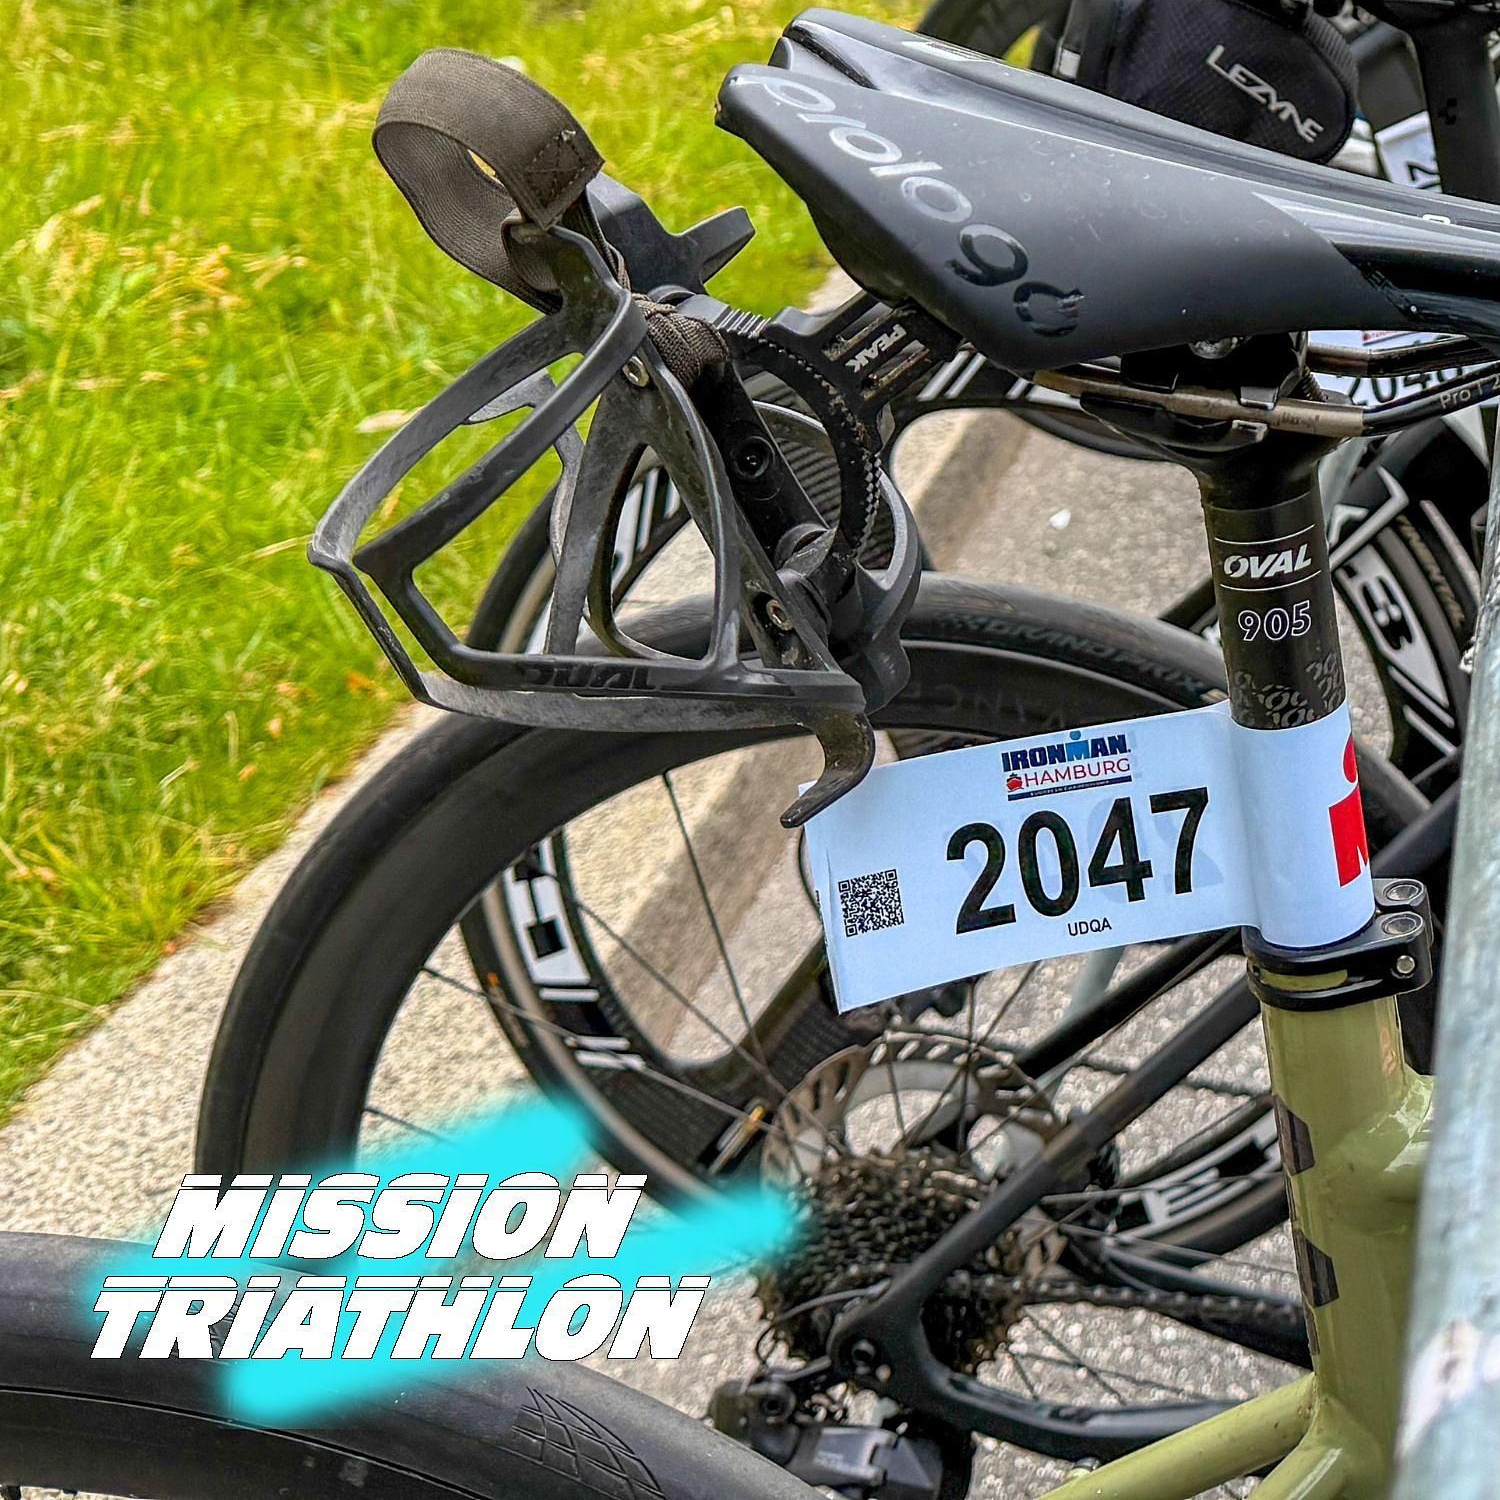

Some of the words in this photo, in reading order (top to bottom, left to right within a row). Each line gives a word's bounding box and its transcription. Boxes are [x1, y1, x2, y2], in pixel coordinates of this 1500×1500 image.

[1206, 44, 1324, 143] LEZYNE
[728, 75, 1085, 338] prologo
[1224, 543, 1312, 579] OVAL
[1238, 600, 1312, 642] 905
[1001, 730, 1131, 773] IRONMAN
[1024, 758, 1130, 787] HAMBURG
[947, 786, 1209, 934] 2047
[1068, 916, 1113, 937] UDQA
